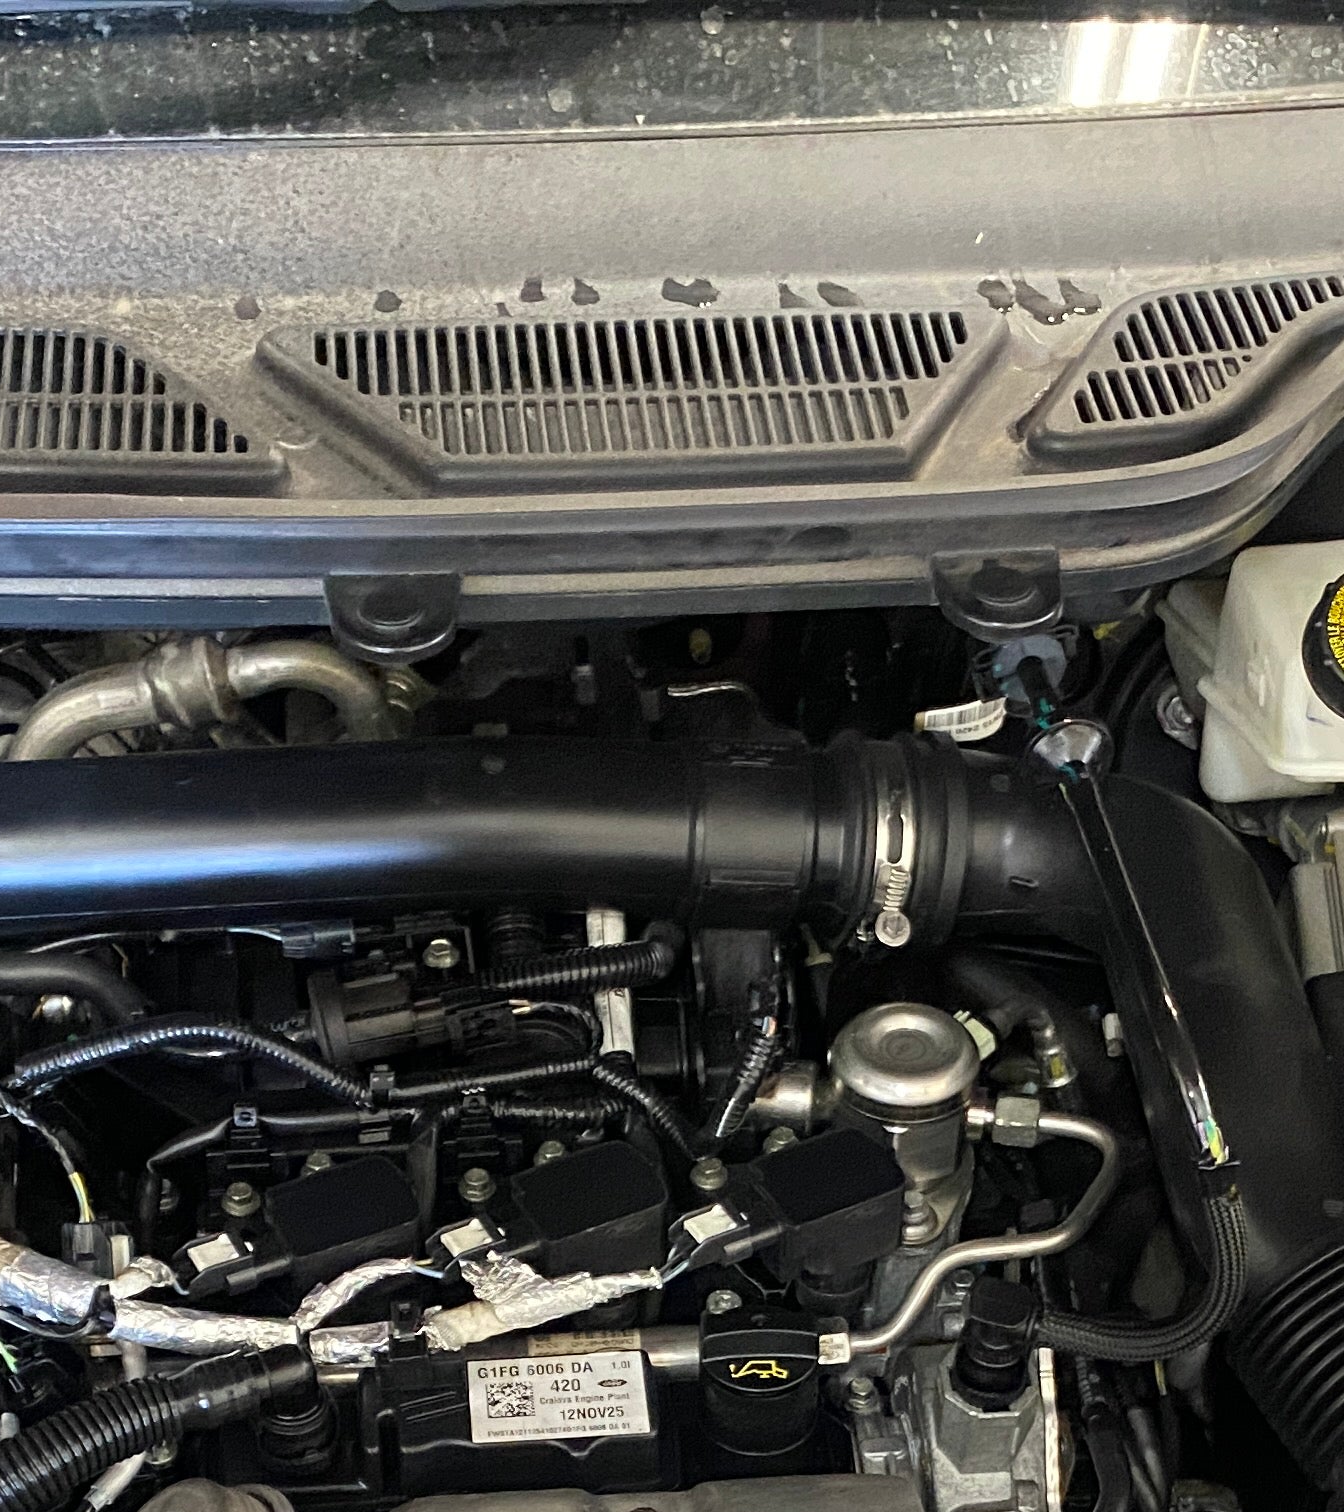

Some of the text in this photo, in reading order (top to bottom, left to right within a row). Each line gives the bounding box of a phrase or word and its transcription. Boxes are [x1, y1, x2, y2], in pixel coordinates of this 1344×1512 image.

[1327, 625, 1339, 635] LE
[477, 1366, 520, 1379] G1FG
[527, 1363, 564, 1376] 6006
[571, 1361, 594, 1374] DA
[550, 1378, 581, 1392] 420
[574, 1394, 605, 1404] Engine
[607, 1392, 631, 1401] Plant
[560, 1406, 625, 1421] 12NOV25
